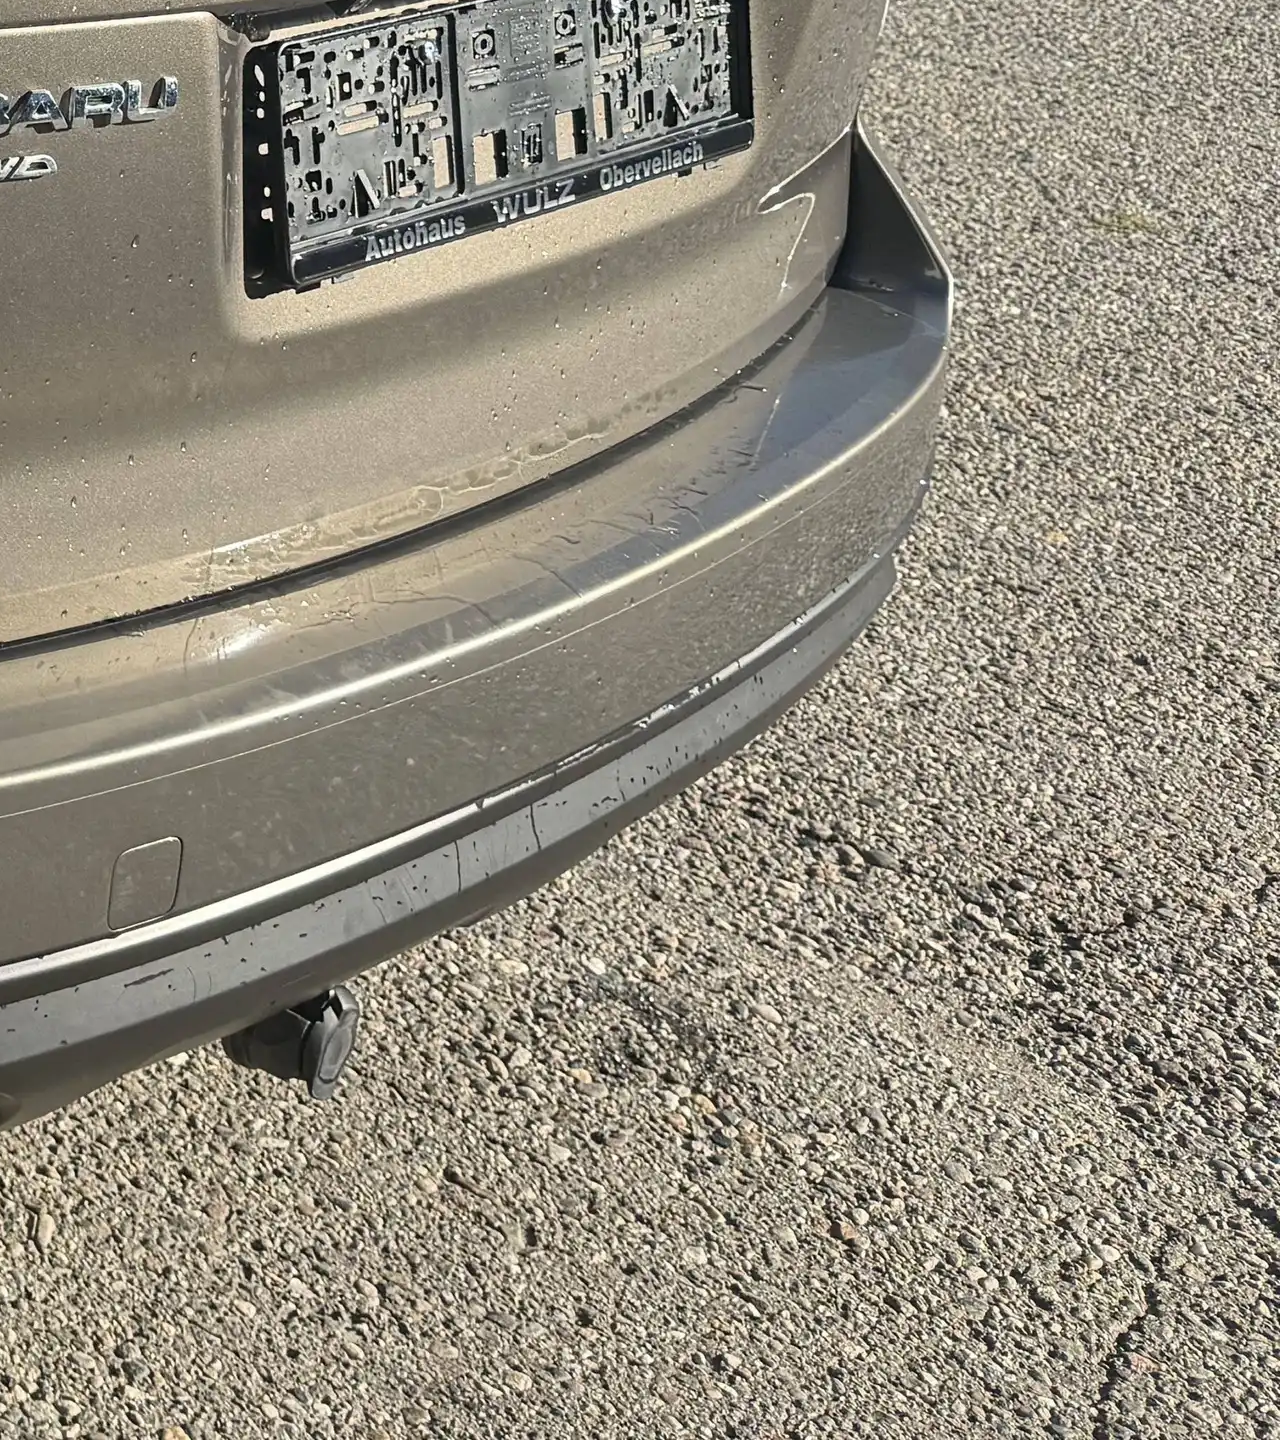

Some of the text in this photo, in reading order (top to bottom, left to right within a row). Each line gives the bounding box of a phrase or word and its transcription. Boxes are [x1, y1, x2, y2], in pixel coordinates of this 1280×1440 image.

[364, 139, 704, 263] Autohaus WULZ Obervellach
